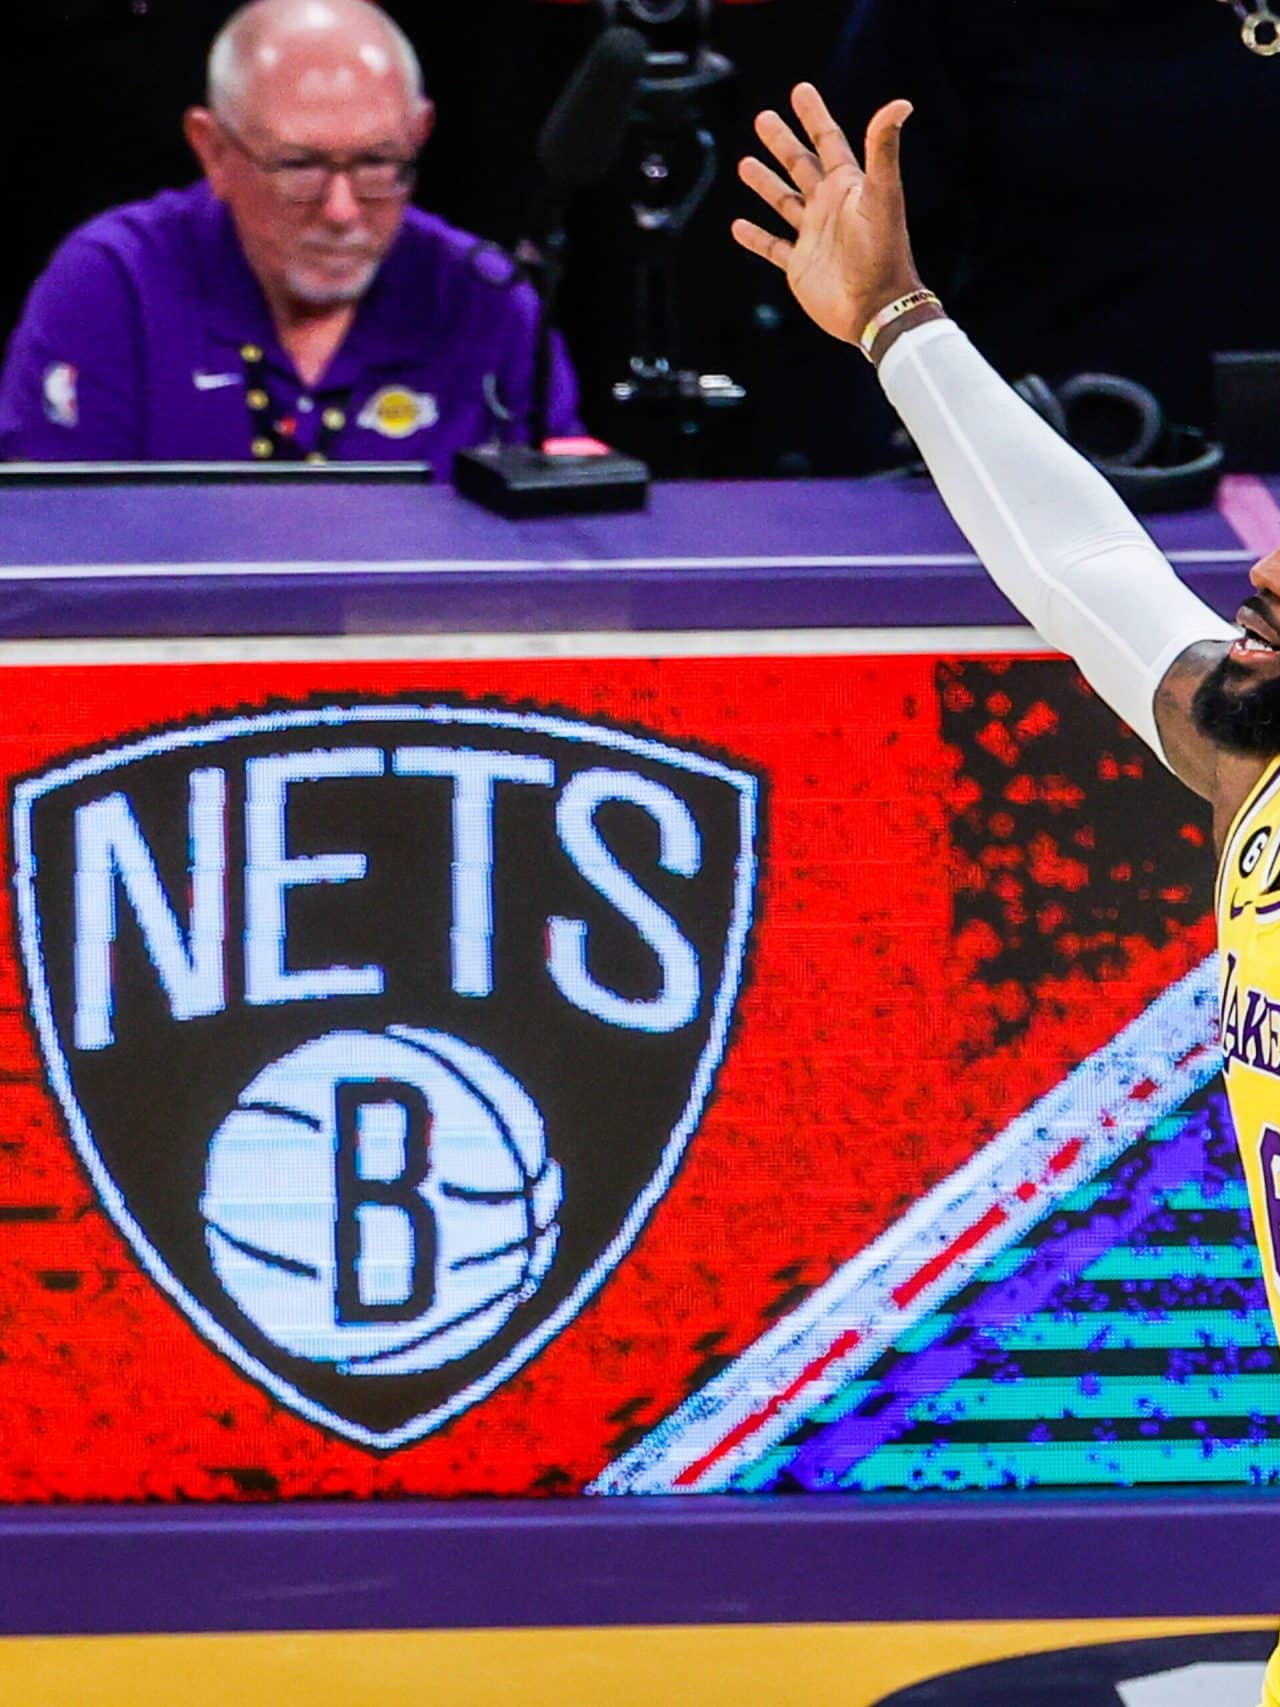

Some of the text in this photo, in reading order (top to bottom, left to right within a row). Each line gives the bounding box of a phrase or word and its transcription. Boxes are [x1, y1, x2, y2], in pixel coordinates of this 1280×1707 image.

[75, 747, 700, 1050] NETS
[1241, 829, 1270, 875] 6
[334, 1078, 438, 1327] B
